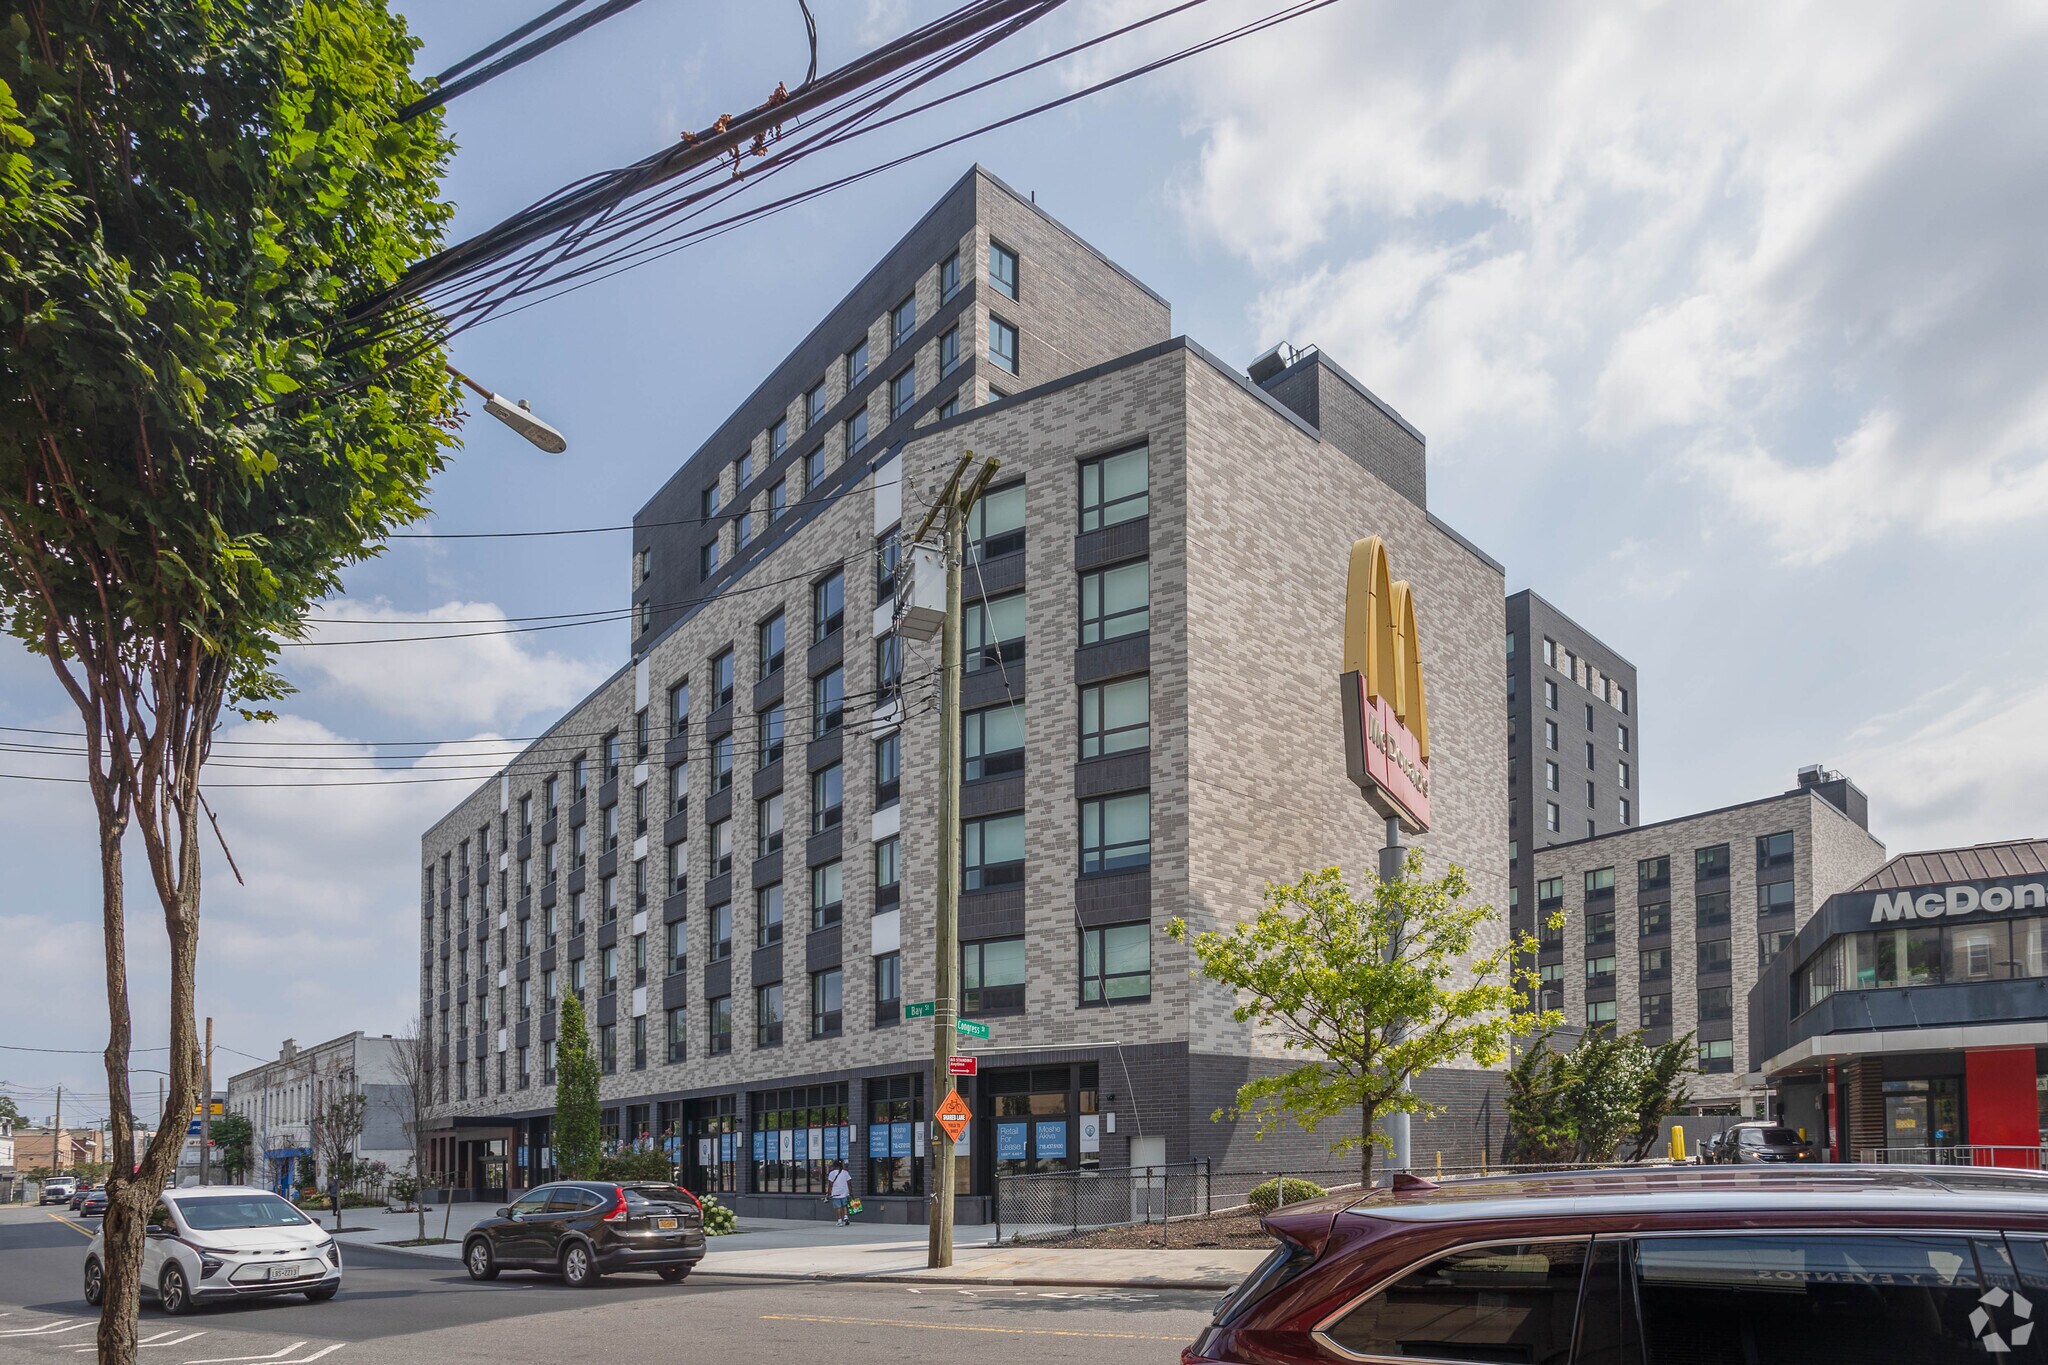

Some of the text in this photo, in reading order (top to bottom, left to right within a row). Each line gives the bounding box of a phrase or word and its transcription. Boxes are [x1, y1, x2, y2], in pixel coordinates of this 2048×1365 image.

[1368, 711, 1429, 799] McDonald's
[1870, 881, 2048, 923] McDon
[911, 1006, 923, 1017] Bay
[957, 1020, 980, 1035] Congress
[1000, 1127, 1019, 1135] Retail
[1000, 1143, 1021, 1151] Lease
